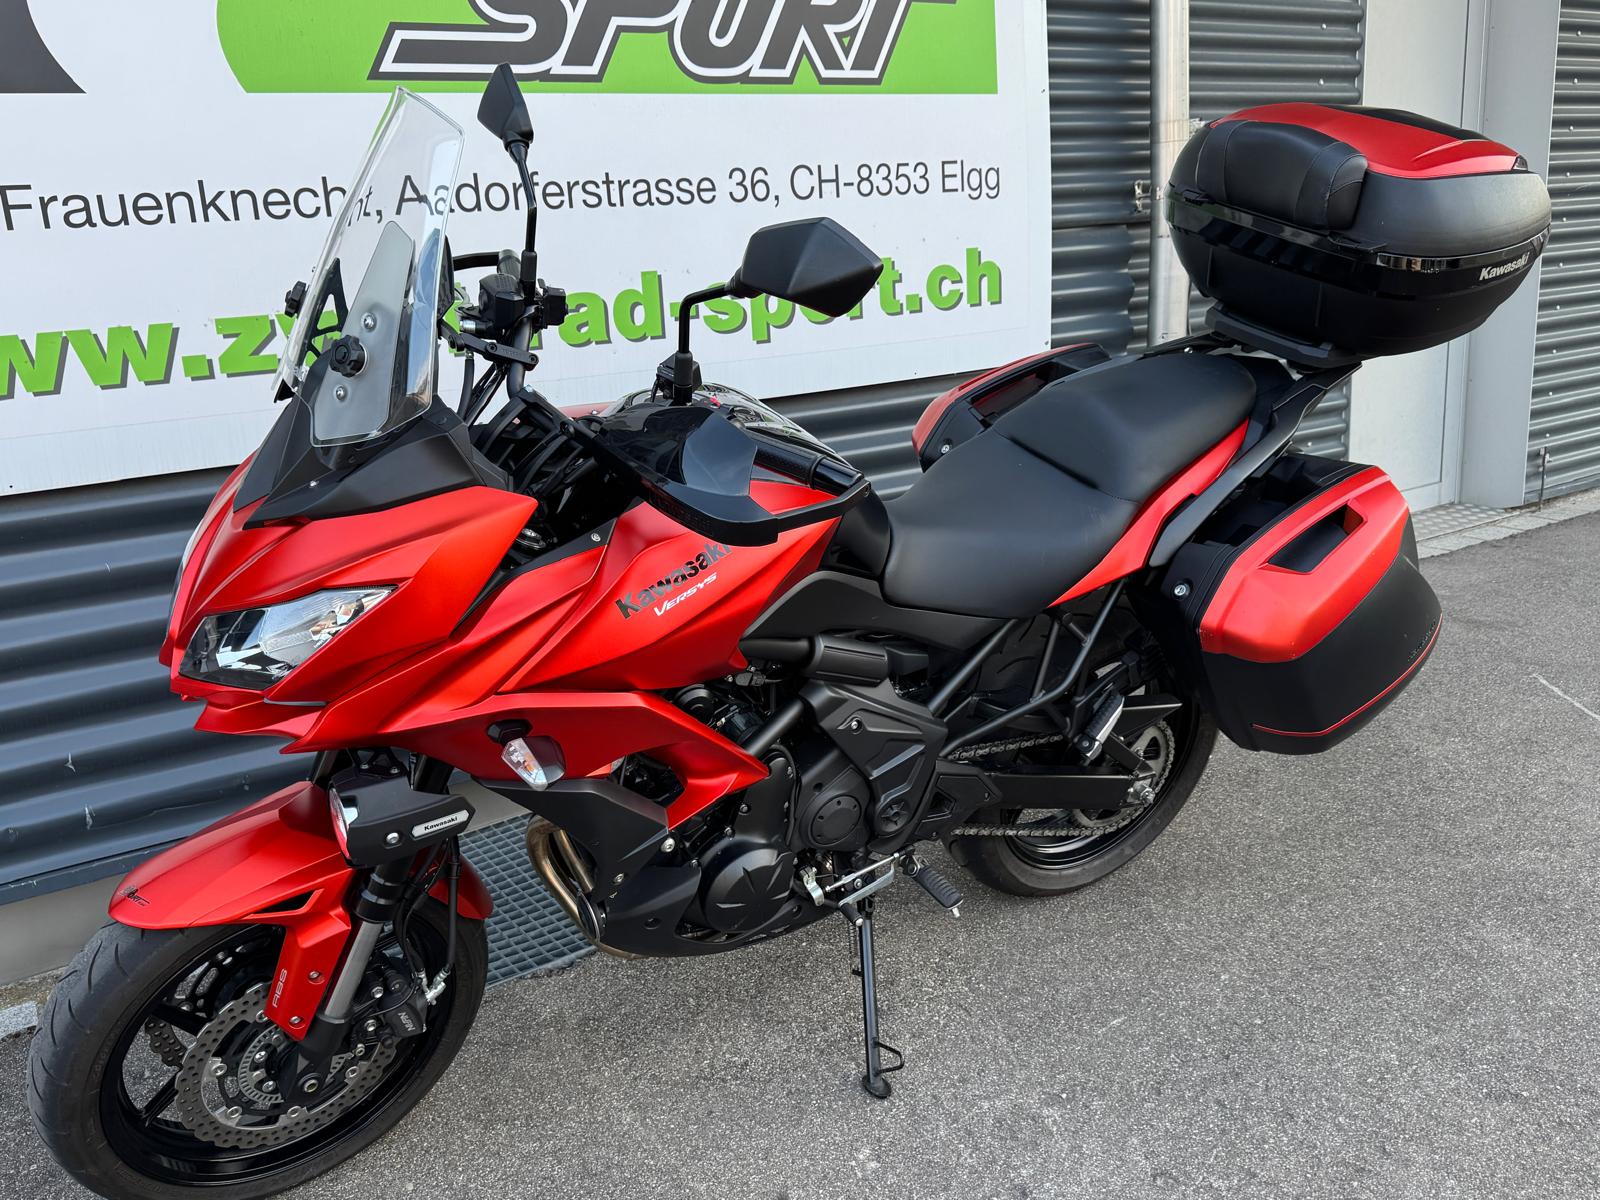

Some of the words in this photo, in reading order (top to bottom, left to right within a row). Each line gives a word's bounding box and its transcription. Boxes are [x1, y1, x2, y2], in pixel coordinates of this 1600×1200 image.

[728, 166, 780, 208] 36,
[790, 161, 930, 200] CH-8353
[941, 159, 1000, 200] Elgg
[1479, 251, 1530, 281] Kawasaki
[615, 543, 732, 619] Kawasaki
[653, 571, 717, 617] VERSYS
[424, 816, 458, 831] Kawasaki
[272, 968, 288, 1008] ABS
